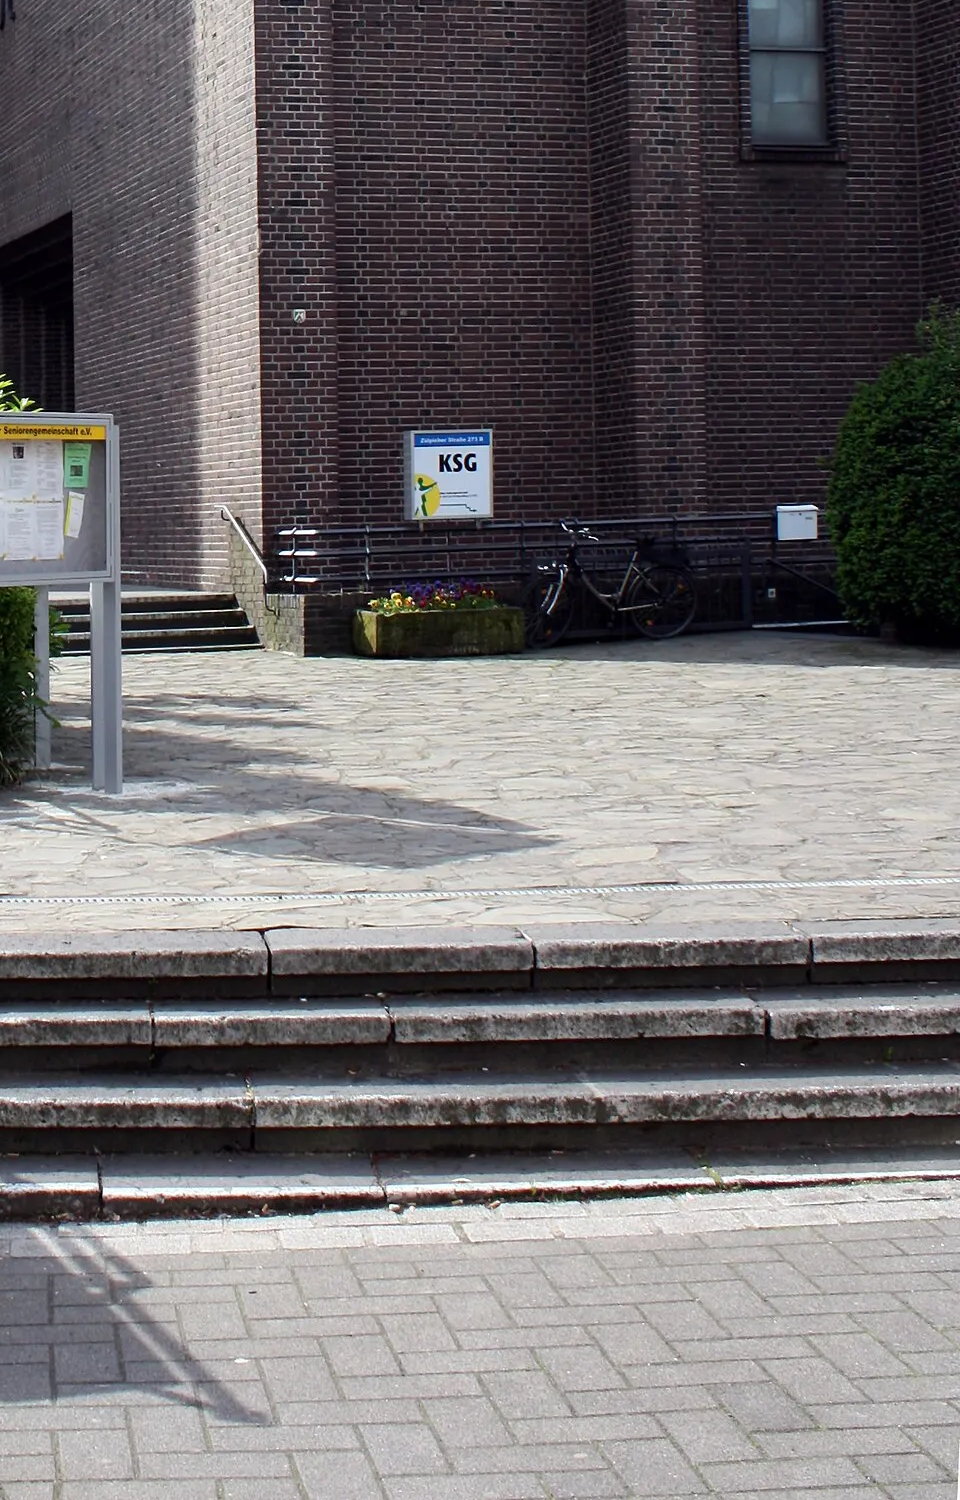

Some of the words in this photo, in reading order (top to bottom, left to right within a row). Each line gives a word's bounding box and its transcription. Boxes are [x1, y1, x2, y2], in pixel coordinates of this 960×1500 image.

[3, 426, 79, 437] Seniorengemeinschaft
[80, 428, 92, 436] e.V.
[438, 453, 477, 473] KSG
